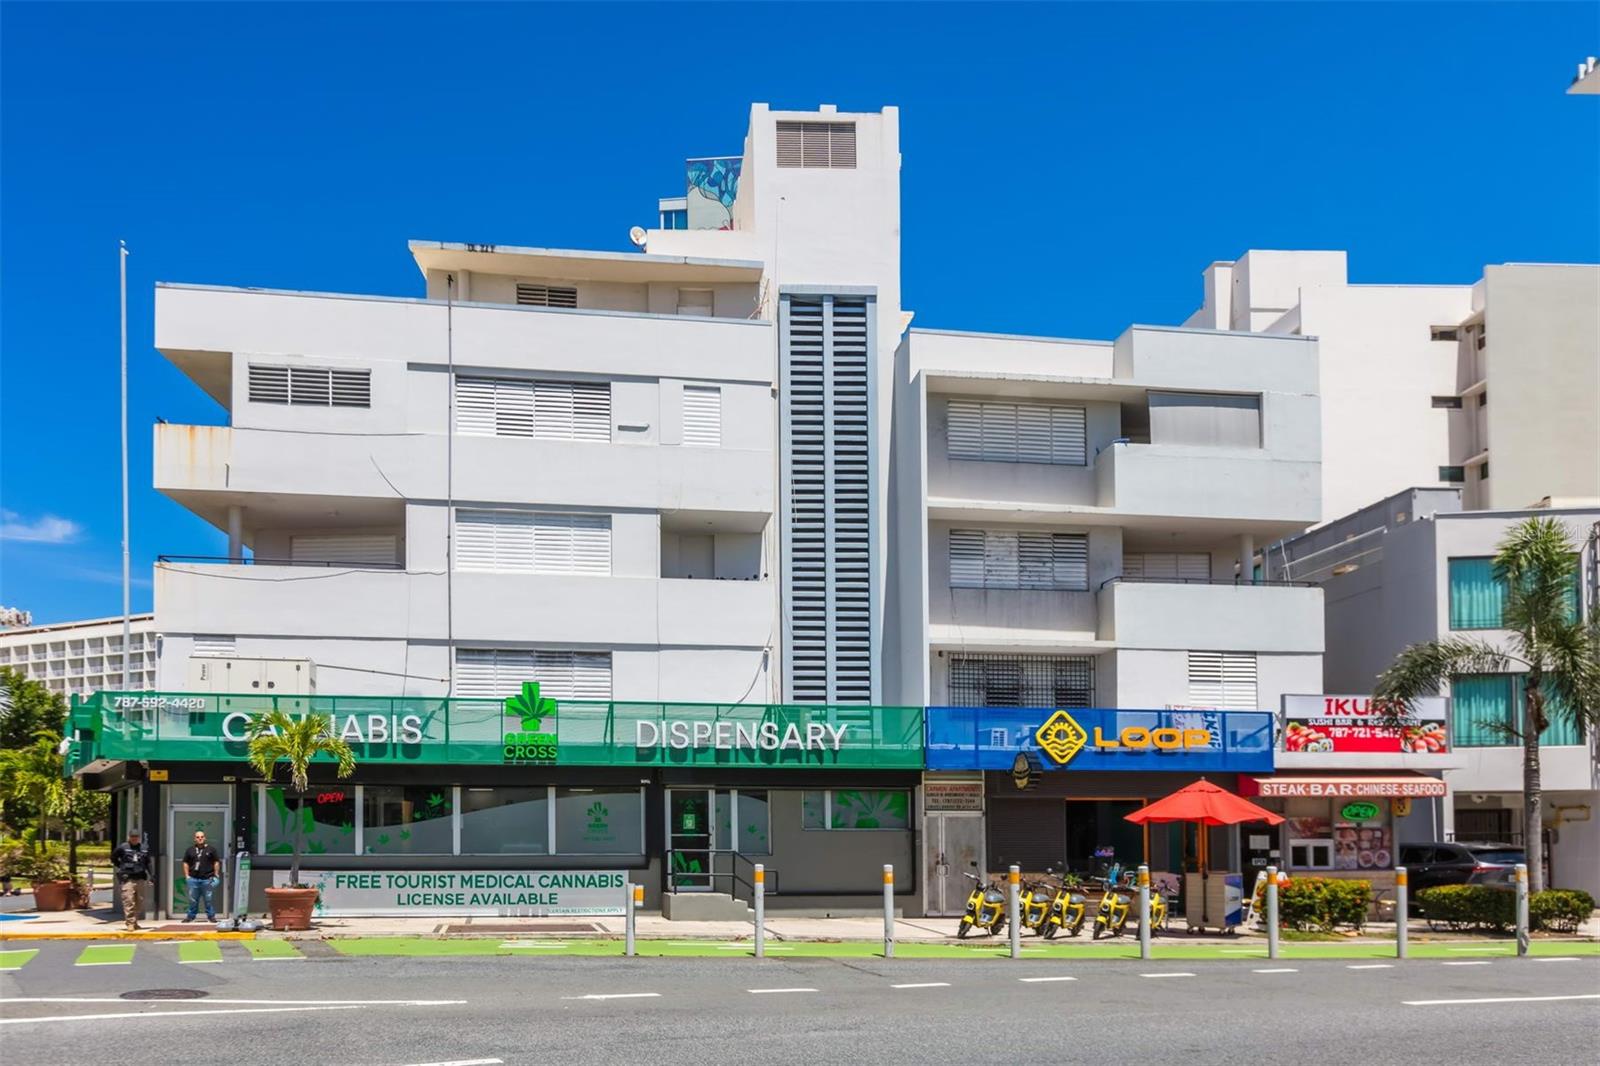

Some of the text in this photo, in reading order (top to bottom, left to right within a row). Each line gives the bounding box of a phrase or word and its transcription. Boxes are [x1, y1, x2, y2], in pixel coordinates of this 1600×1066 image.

[114, 697, 205, 709] 787-592-4420
[504, 732, 557, 745] GREEN
[635, 719, 848, 751] DISPENSARY
[1094, 726, 1212, 750] LOOP
[504, 745, 557, 758] CROSS
[317, 792, 344, 804] OPEN
[1345, 805, 1374, 818] OPEN
[336, 874, 624, 889] FREE TOURIST MEDICAL CANNABIS
[397, 892, 559, 906] LICENSE AVAILABLE
